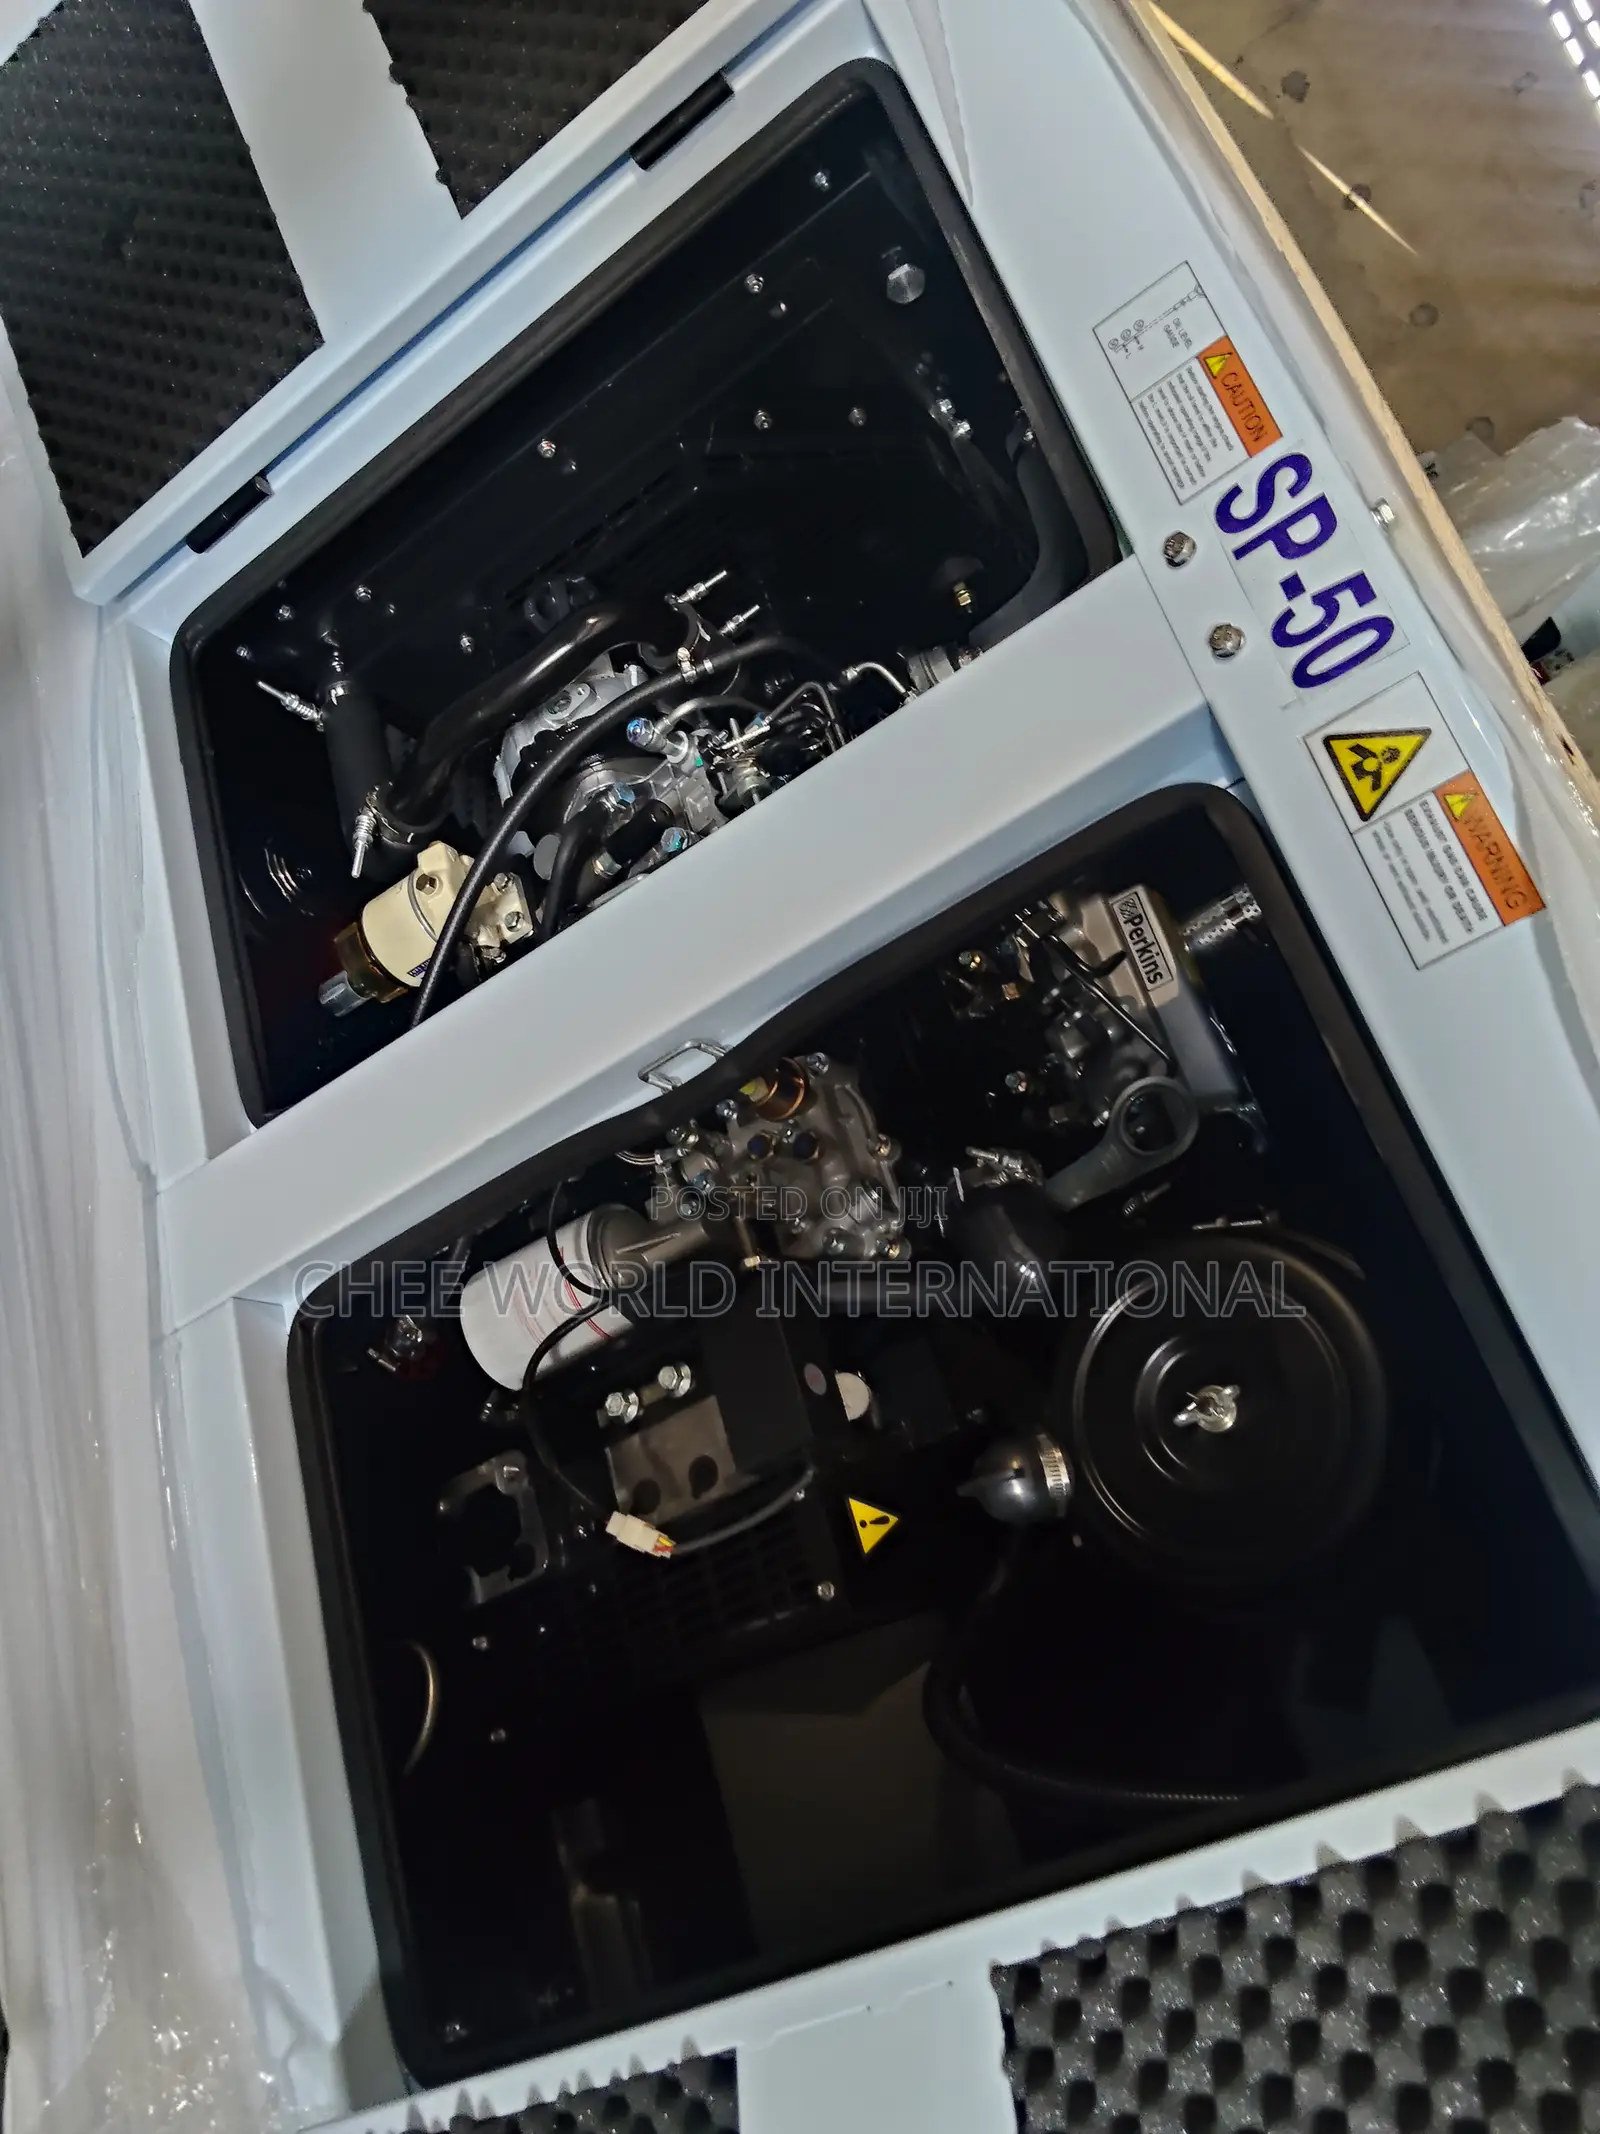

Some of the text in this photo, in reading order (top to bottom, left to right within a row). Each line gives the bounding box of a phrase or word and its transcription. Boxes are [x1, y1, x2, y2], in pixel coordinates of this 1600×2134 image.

[1221, 372, 1268, 442] CAUTION
[1215, 452, 1395, 688] SP-50
[1464, 813, 1527, 910] WARNING
[1123, 913, 1163, 985] Perkins
